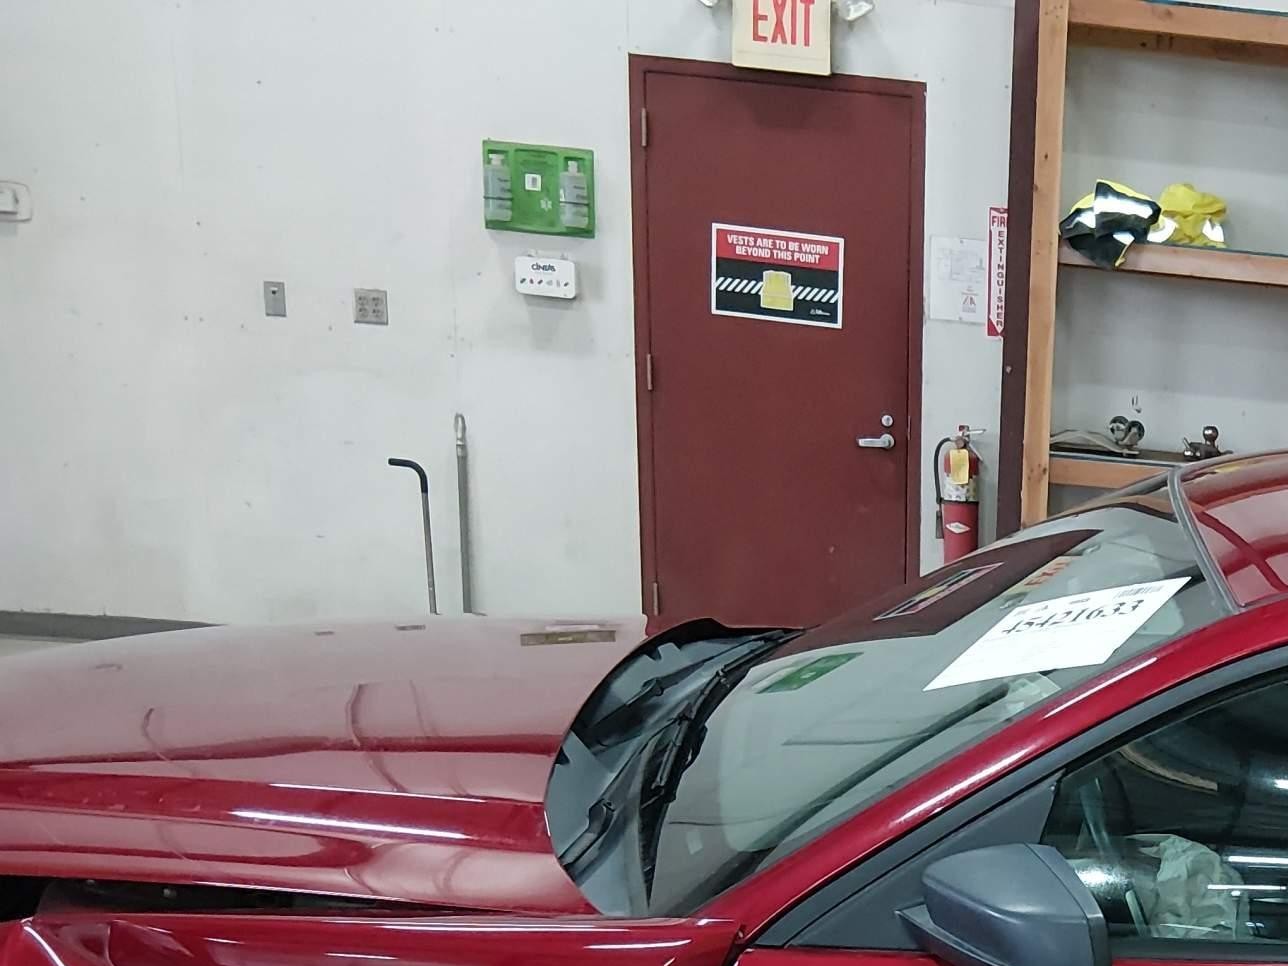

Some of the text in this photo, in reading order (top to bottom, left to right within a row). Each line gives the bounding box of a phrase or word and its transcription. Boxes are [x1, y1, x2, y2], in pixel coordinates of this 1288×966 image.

[752, 0, 815, 47] EXIT
[991, 215, 1007, 228] FIR
[727, 234, 829, 256] VESTS ARE TO BE WORN
[736, 246, 820, 264] BEYOND THIS POINT
[996, 230, 1005, 327] EXTINGUISHER
